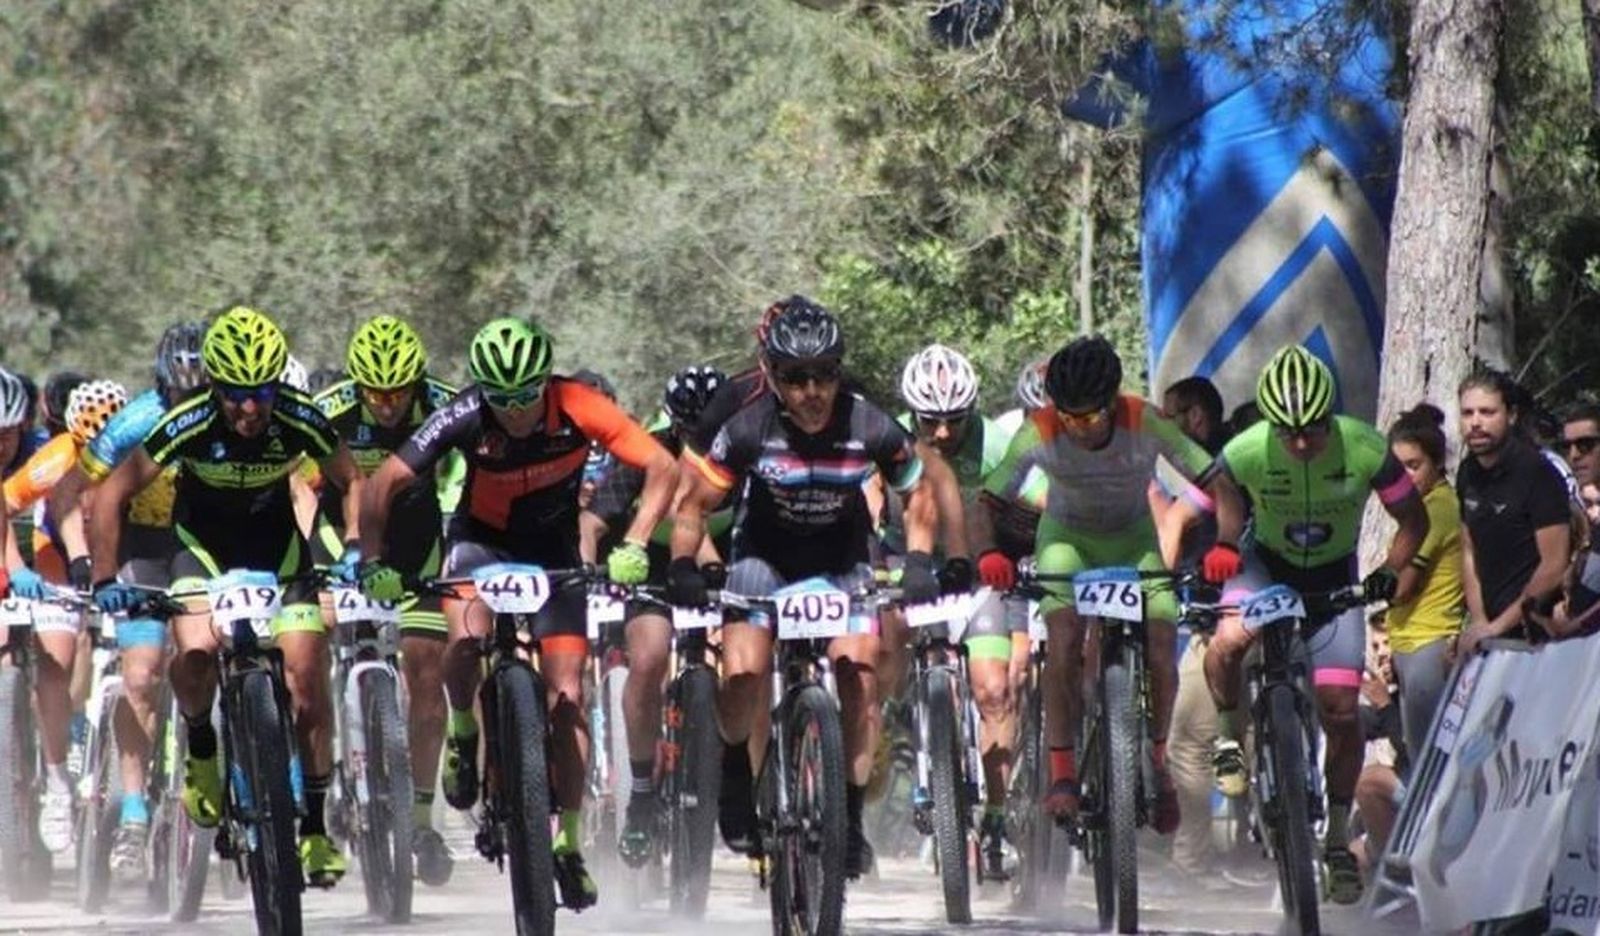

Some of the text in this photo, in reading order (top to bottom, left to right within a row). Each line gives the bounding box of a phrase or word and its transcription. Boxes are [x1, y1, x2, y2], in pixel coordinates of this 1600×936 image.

[481, 574, 539, 597] 441
[1079, 582, 1138, 607] 476
[215, 587, 276, 610] 419
[782, 594, 844, 622] 405
